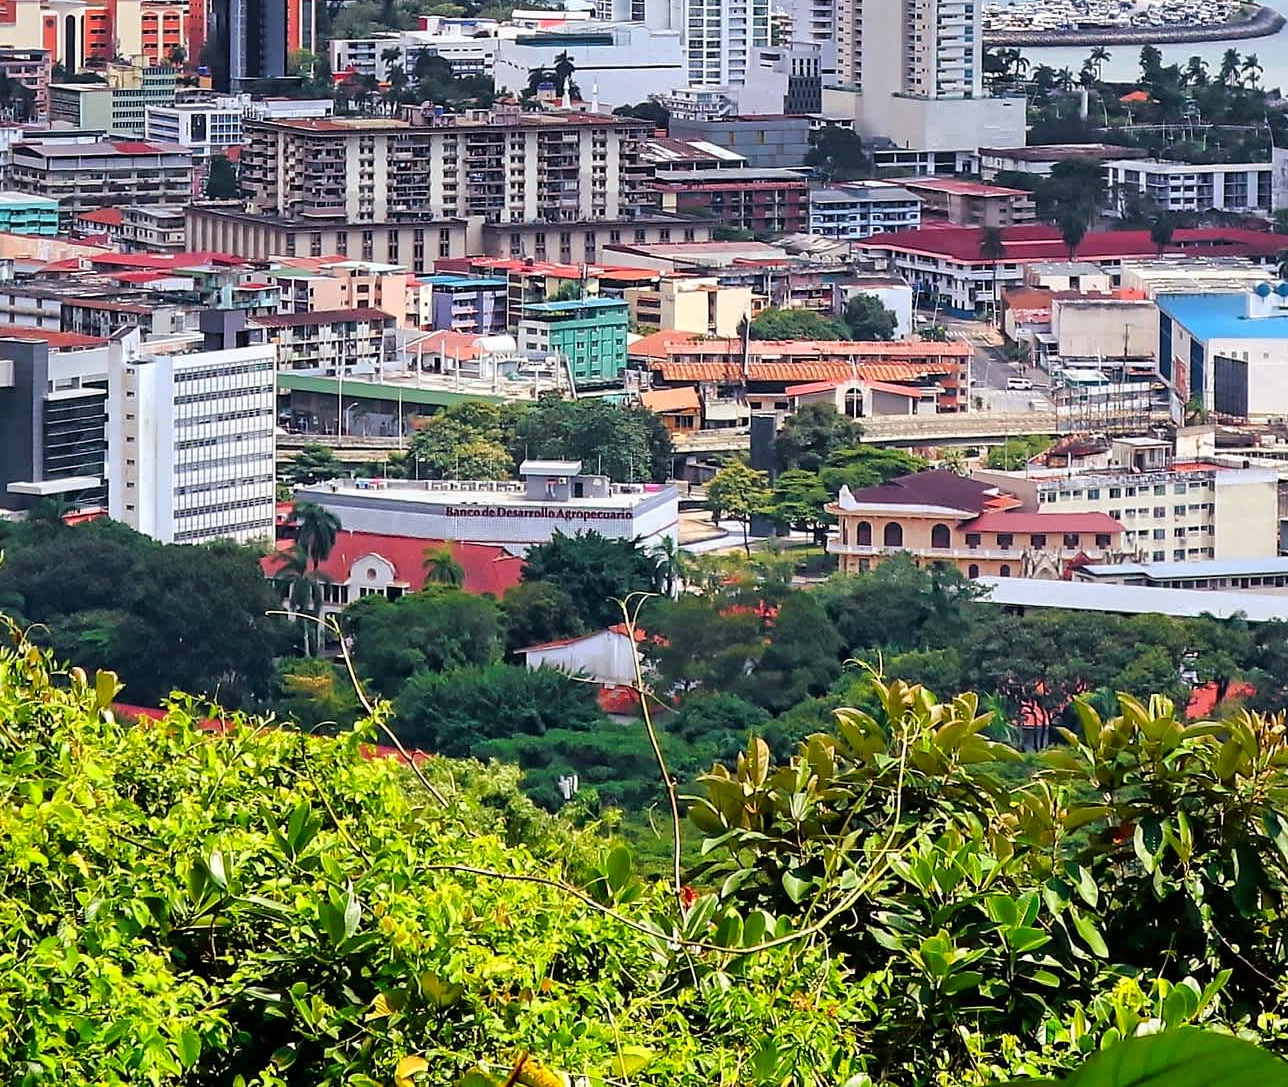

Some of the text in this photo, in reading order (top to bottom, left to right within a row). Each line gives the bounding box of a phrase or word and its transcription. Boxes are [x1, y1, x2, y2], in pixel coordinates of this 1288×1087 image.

[446, 506, 633, 521] Banco de Desarrollo Agropecuario
